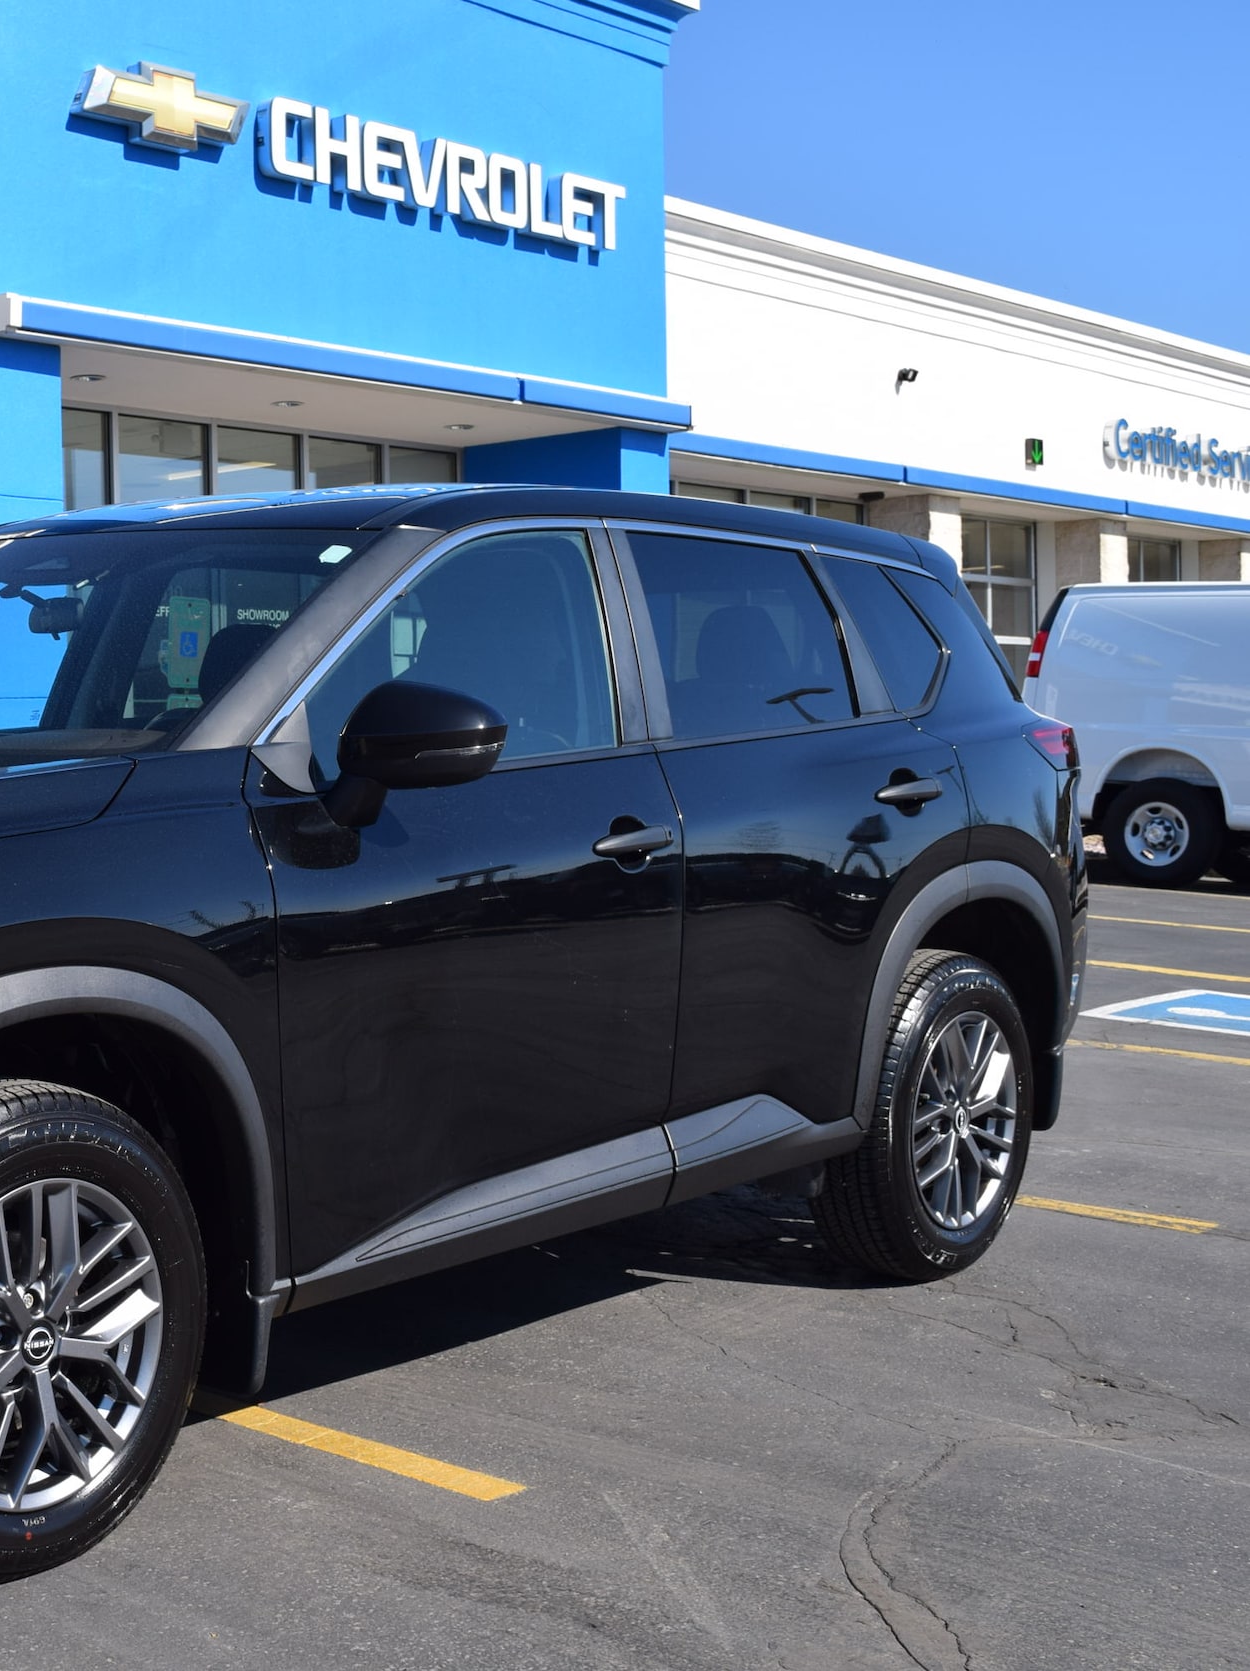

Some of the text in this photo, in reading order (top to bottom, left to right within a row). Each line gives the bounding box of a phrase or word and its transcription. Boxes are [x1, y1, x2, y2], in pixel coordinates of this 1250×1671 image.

[263, 96, 626, 251] CHEVROLET
[1113, 418, 1201, 473] Certified
[236, 608, 290, 621] SHOWROOM
[23, 1338, 55, 1350] NISSAN
